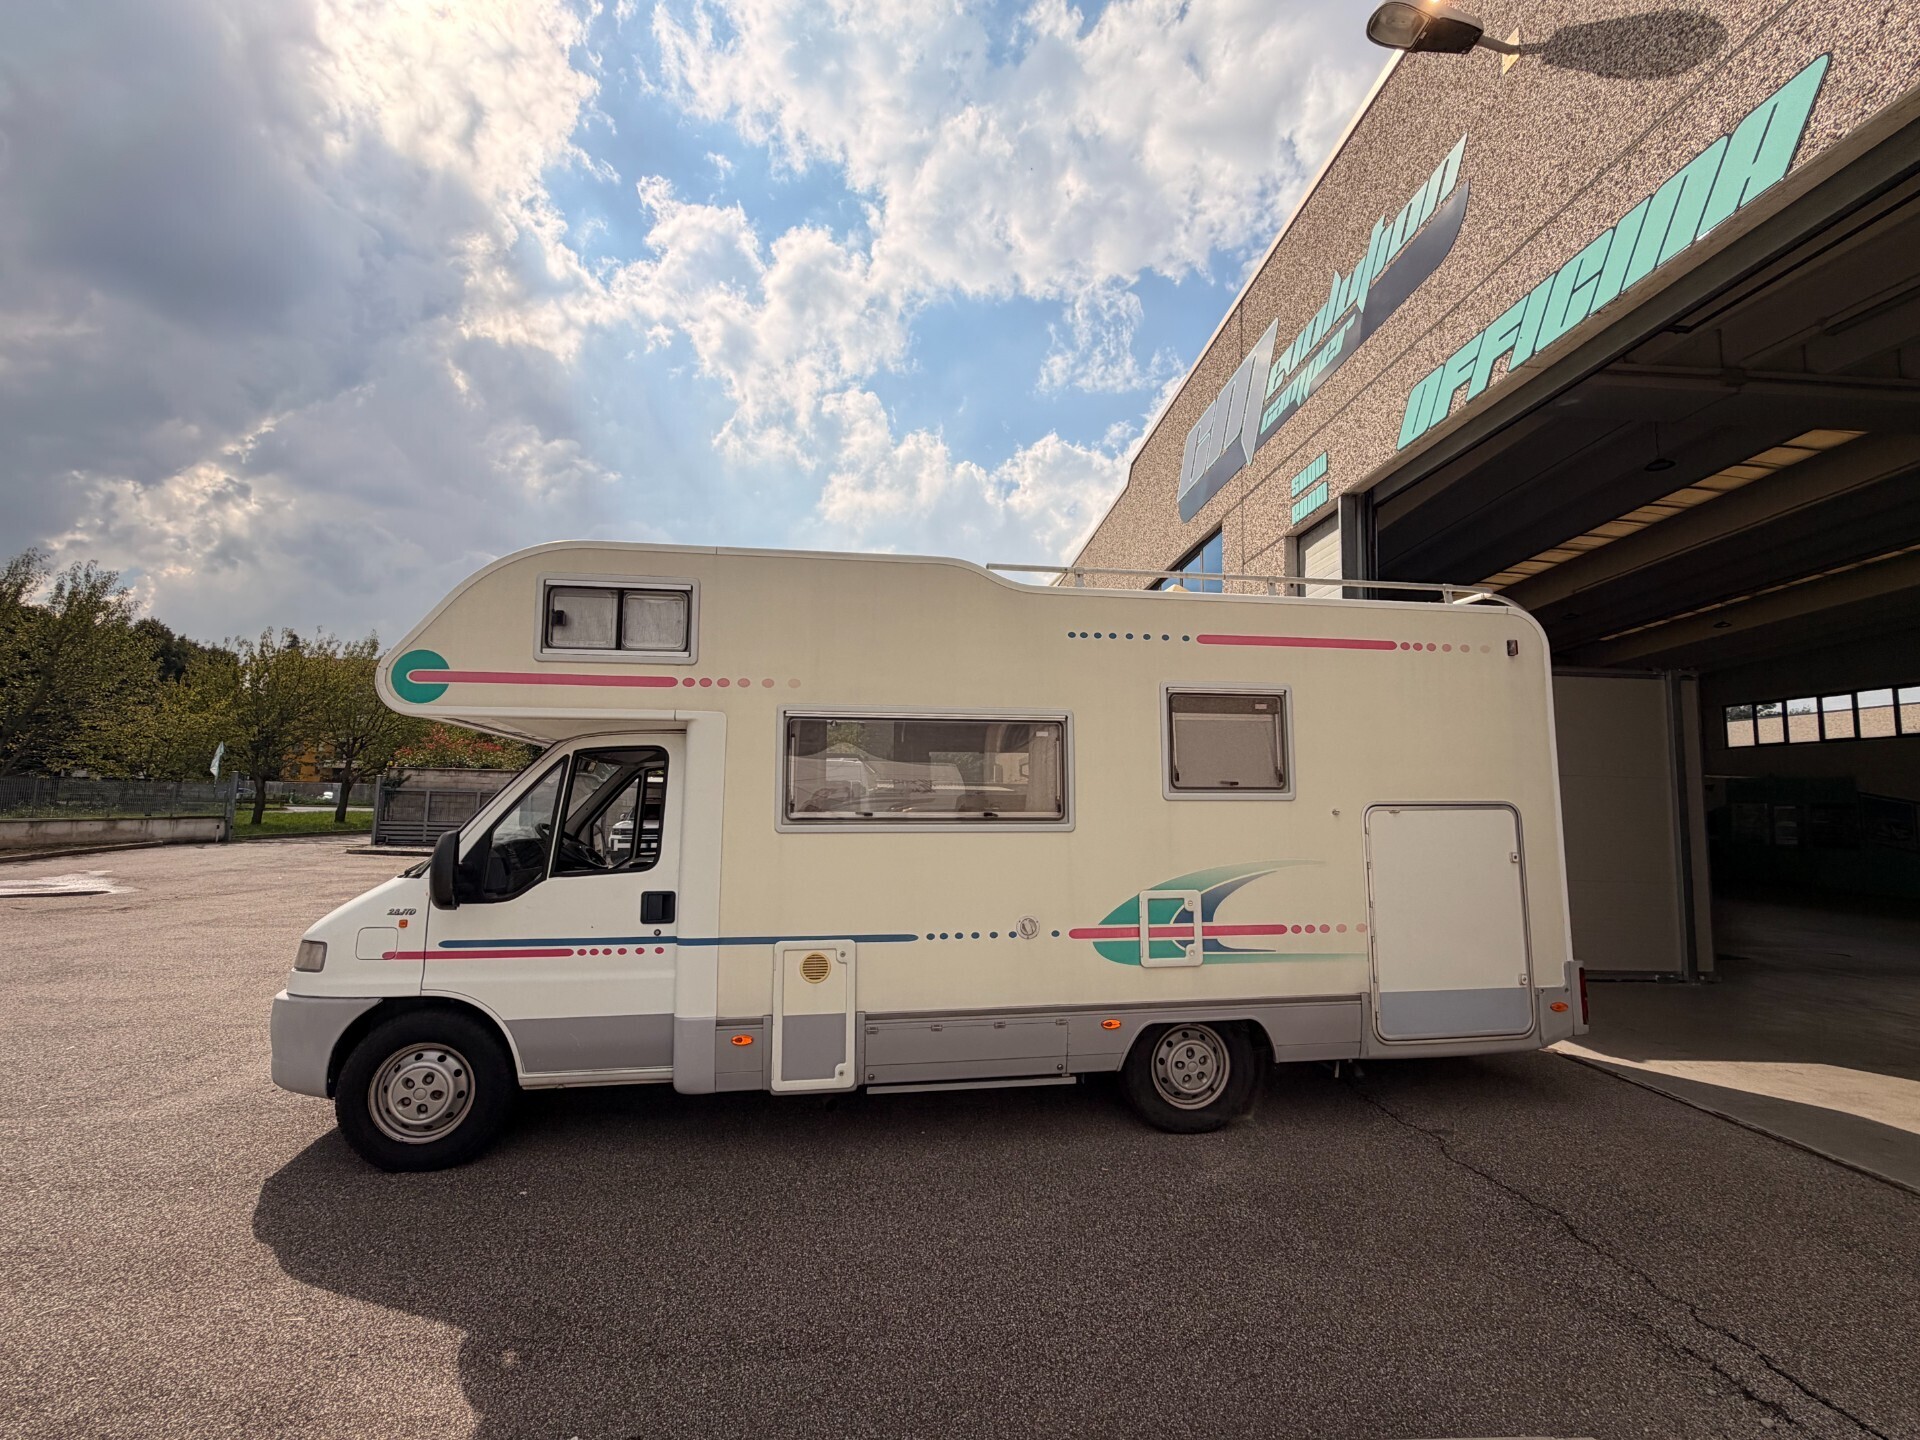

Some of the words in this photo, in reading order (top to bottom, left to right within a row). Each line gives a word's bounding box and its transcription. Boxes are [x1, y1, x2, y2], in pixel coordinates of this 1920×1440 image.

[1259, 313, 1356, 435] camper
[1265, 132, 1468, 401] evolution
[1396, 52, 1832, 451] OFFICINA
